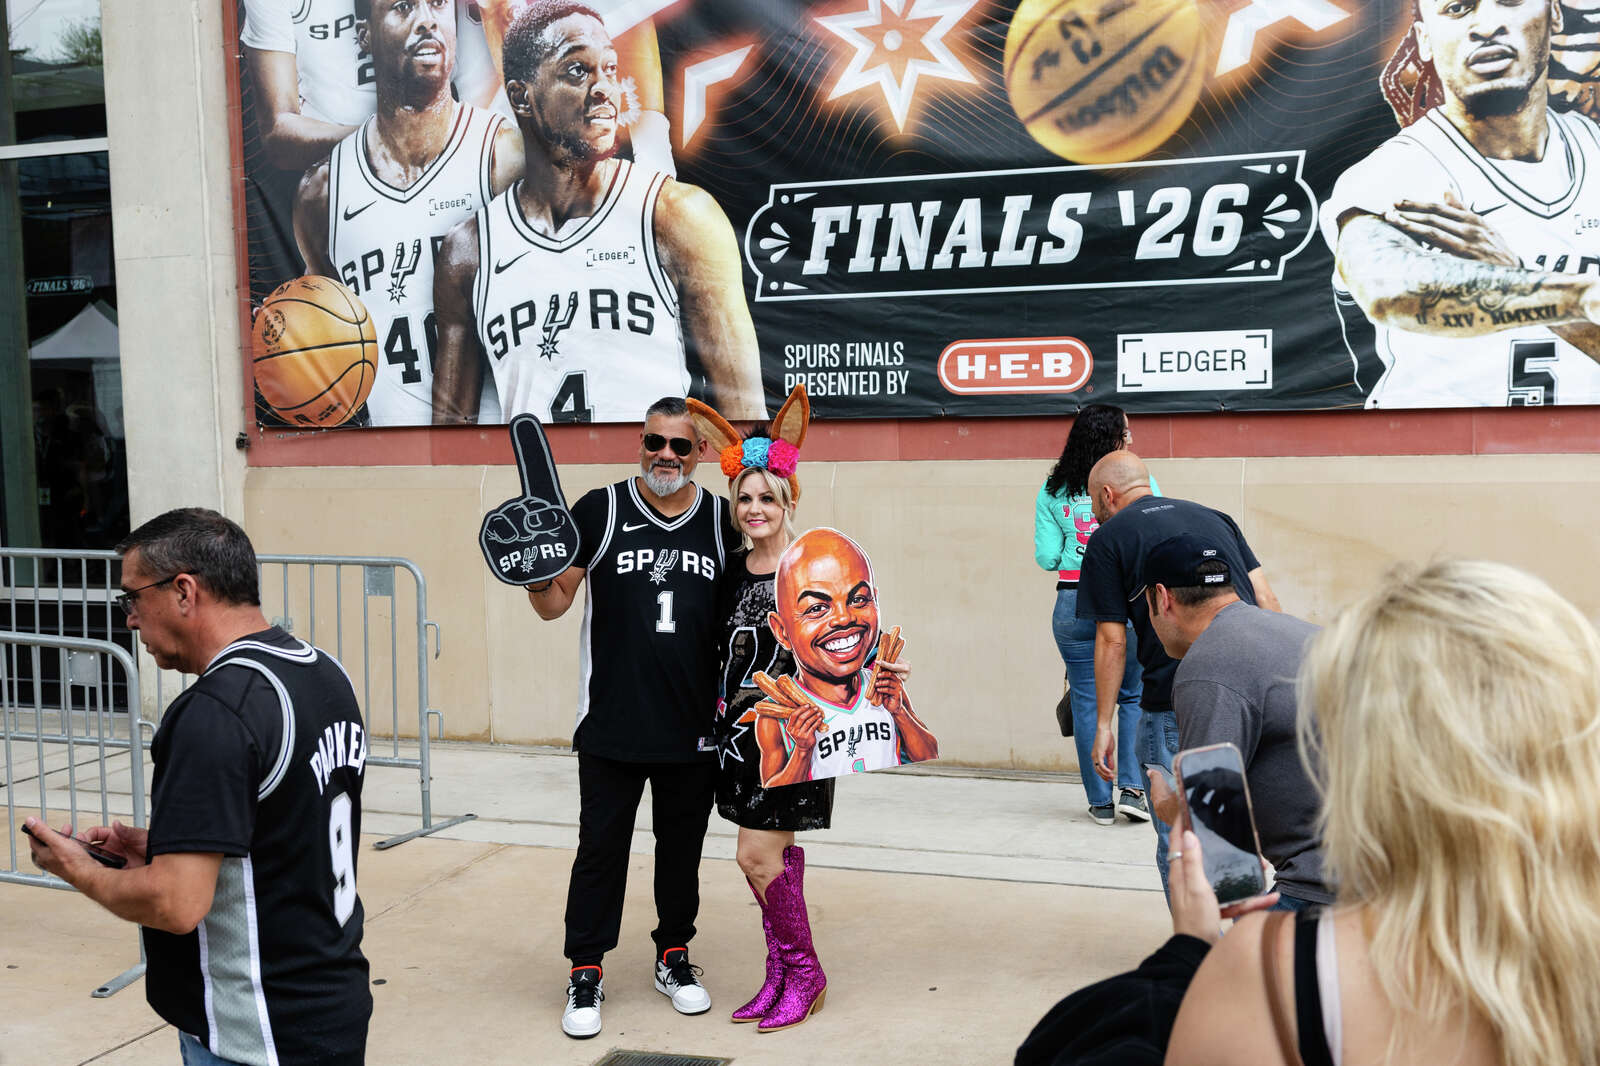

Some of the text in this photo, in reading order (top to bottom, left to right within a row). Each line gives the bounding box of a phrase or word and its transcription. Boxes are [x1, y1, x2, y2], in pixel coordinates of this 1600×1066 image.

[434, 198, 466, 211] LEDGER
[802, 183, 1250, 276] FINALS '26
[592, 251, 629, 262] LEDGER
[33, 281, 68, 292] FINALS
[486, 288, 656, 362] SPURS
[784, 341, 904, 368] SPURS FINALS
[1142, 349, 1246, 373] LEDGER
[1508, 339, 1559, 406] 5
[549, 370, 594, 424] 4
[784, 370, 909, 397] PRESENTED BY
[499, 542, 567, 573] SPURS
[617, 548, 715, 585] SPURS
[656, 590, 675, 633] 1
[818, 722, 891, 760] SPURS
[329, 791, 357, 929] 9
